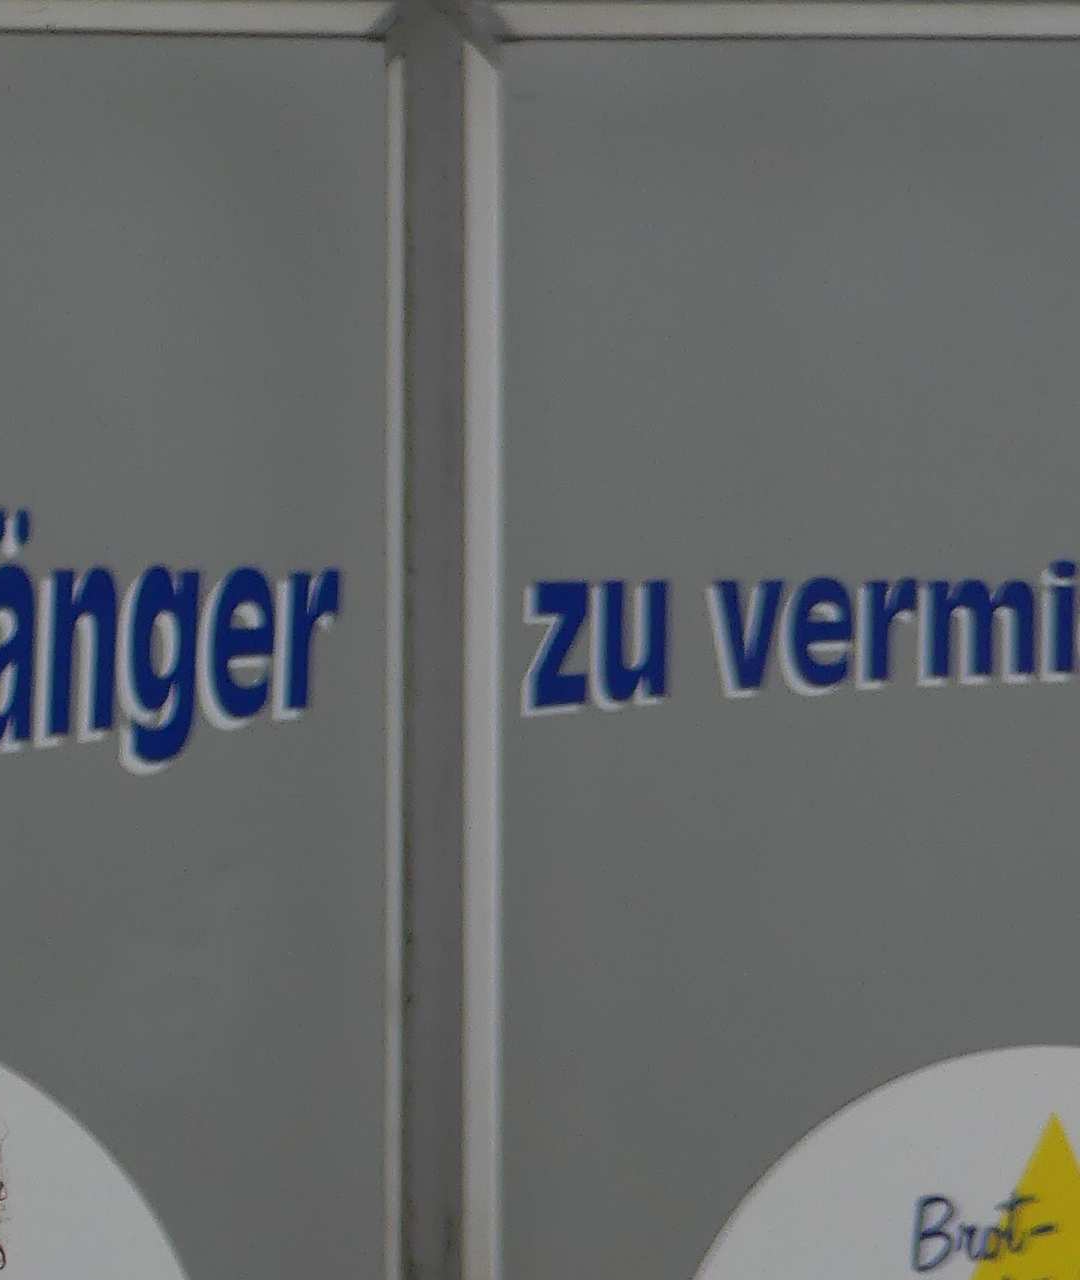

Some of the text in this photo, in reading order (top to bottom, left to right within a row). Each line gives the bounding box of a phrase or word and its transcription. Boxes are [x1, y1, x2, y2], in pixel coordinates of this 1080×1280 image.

[523, 578, 670, 717] zu
[706, 560, 1080, 699] vermi
[910, 1189, 1058, 1272] Brot-
